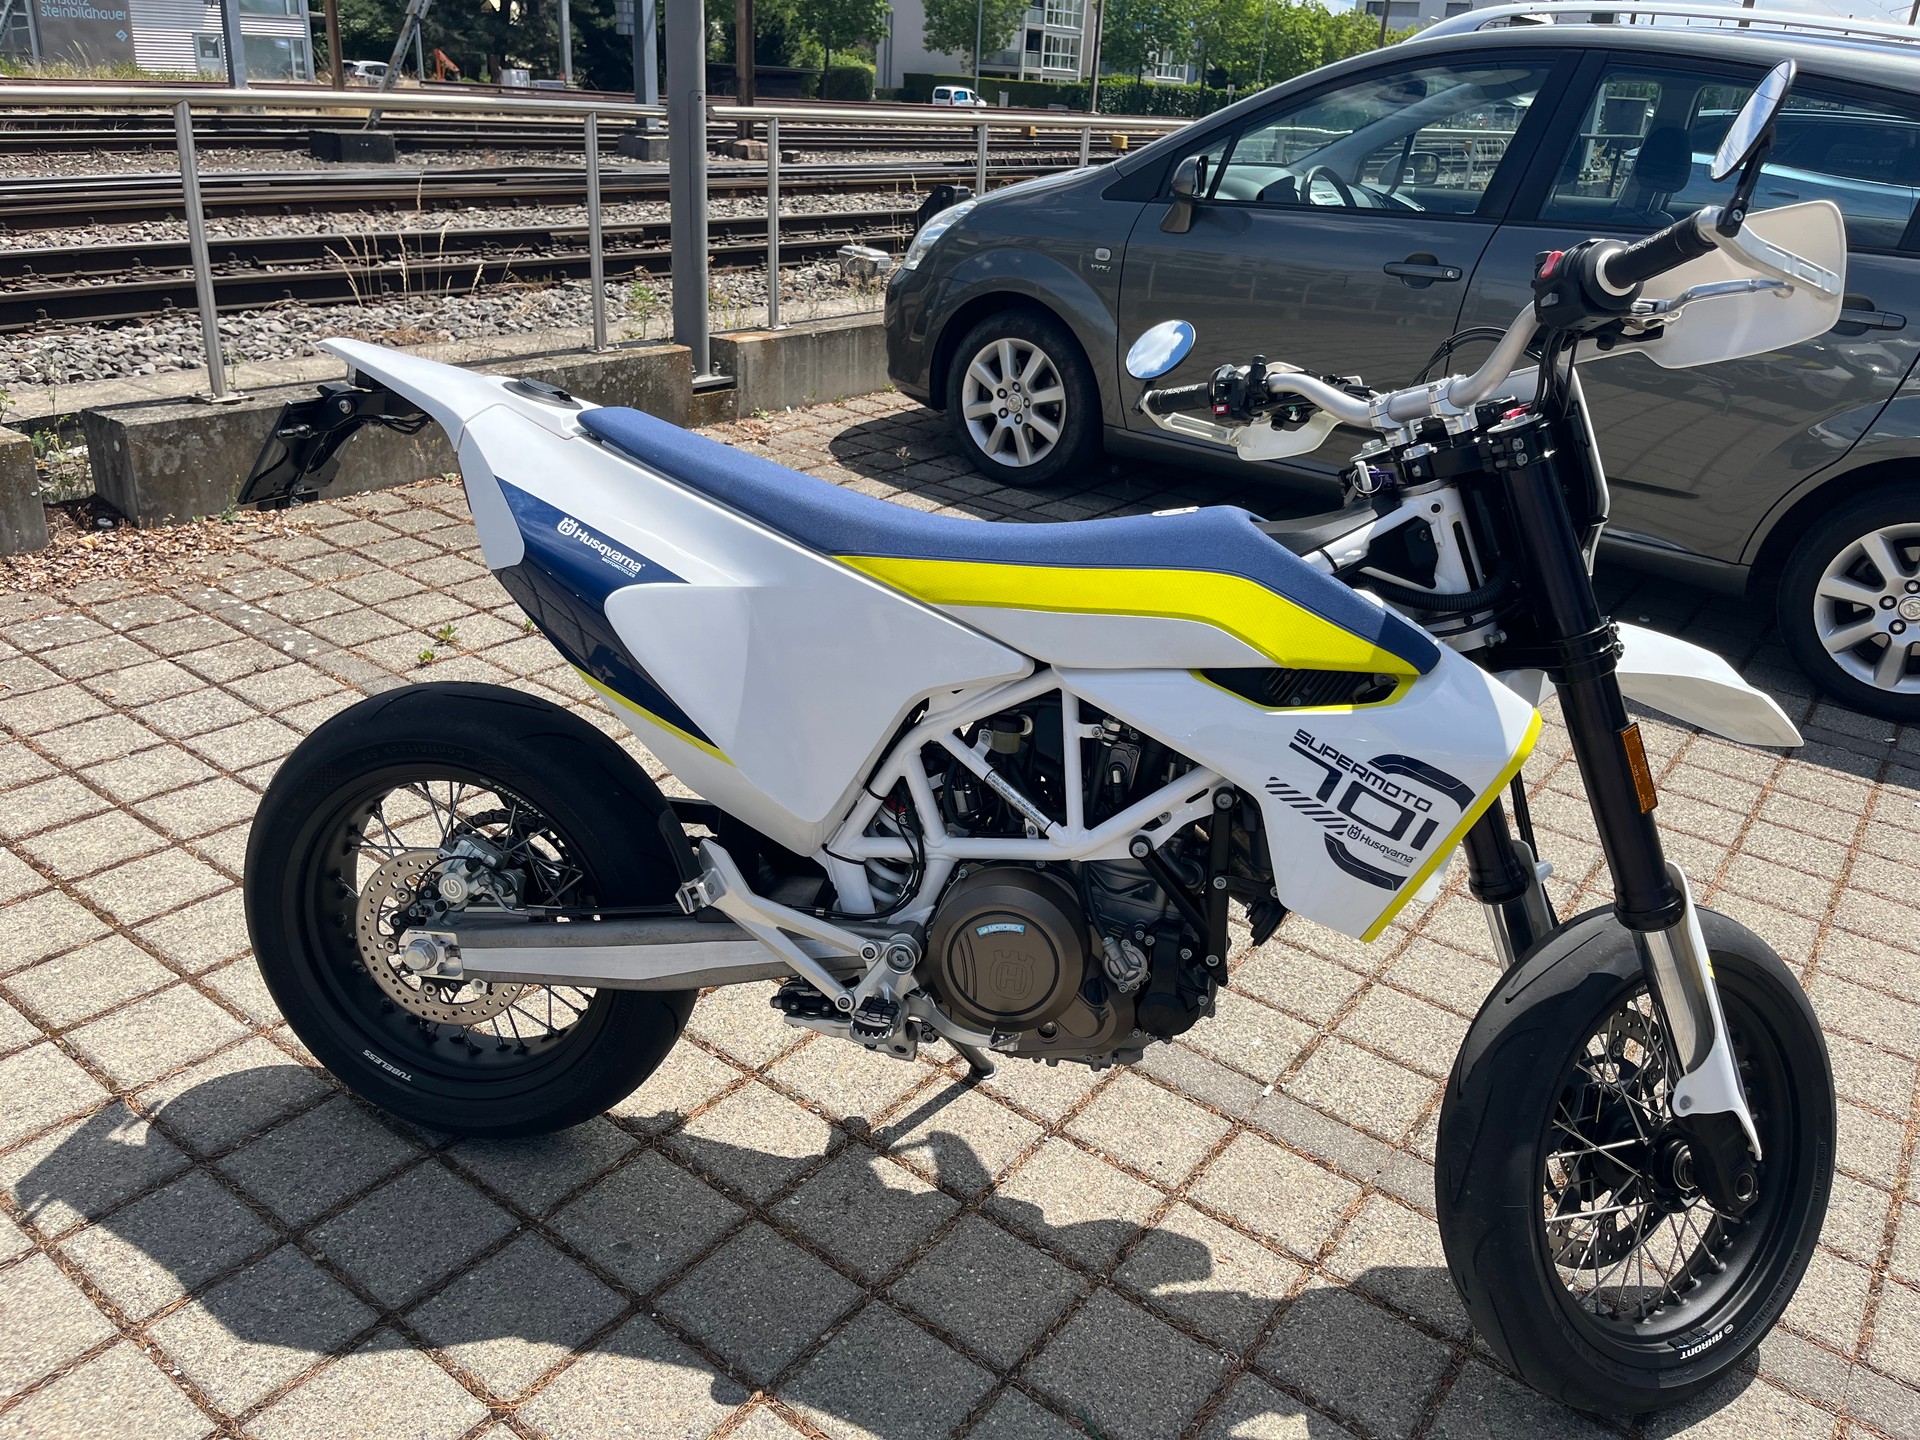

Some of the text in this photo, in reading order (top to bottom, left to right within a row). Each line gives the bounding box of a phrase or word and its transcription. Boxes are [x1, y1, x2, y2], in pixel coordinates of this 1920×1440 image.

[41, 6, 127, 20] steinbildhauer
[573, 528, 642, 572] Husqvarna
[601, 556, 636, 578] MOTORCYCLES
[1294, 728, 1433, 813] SUPERMOTO
[1360, 835, 1414, 865] Husqvarna
[362, 1049, 411, 1082] TUBELESS
